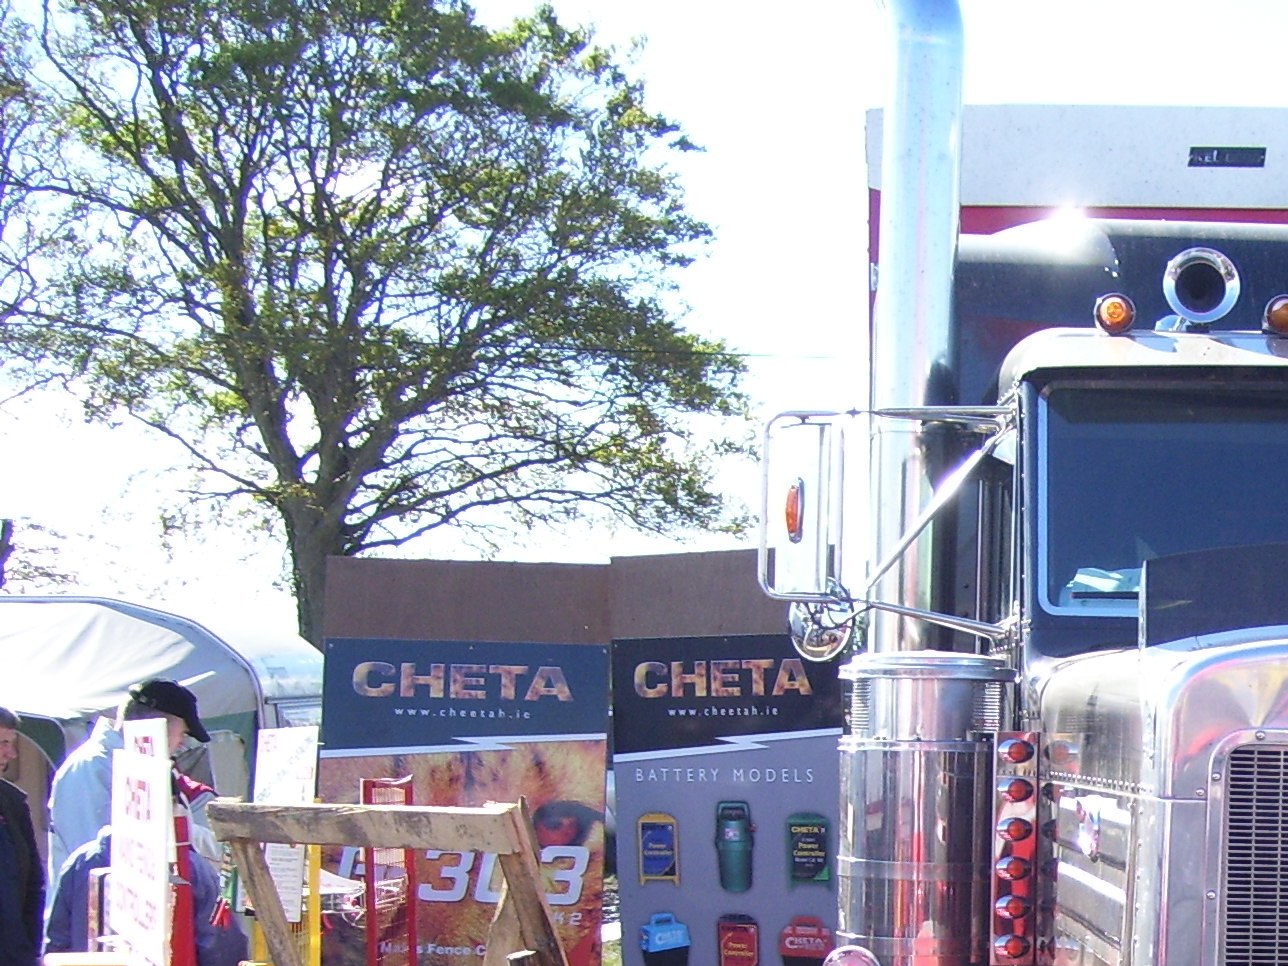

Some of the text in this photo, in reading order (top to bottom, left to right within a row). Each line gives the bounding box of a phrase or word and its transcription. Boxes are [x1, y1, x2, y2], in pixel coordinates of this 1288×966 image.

[352, 661, 575, 701] CHETA
[634, 658, 813, 698] CHETA
[394, 707, 531, 720] www.cheetah.ie
[667, 706, 779, 716] www.cheetah.ie
[635, 768, 814, 783] BATTERY MODELS
